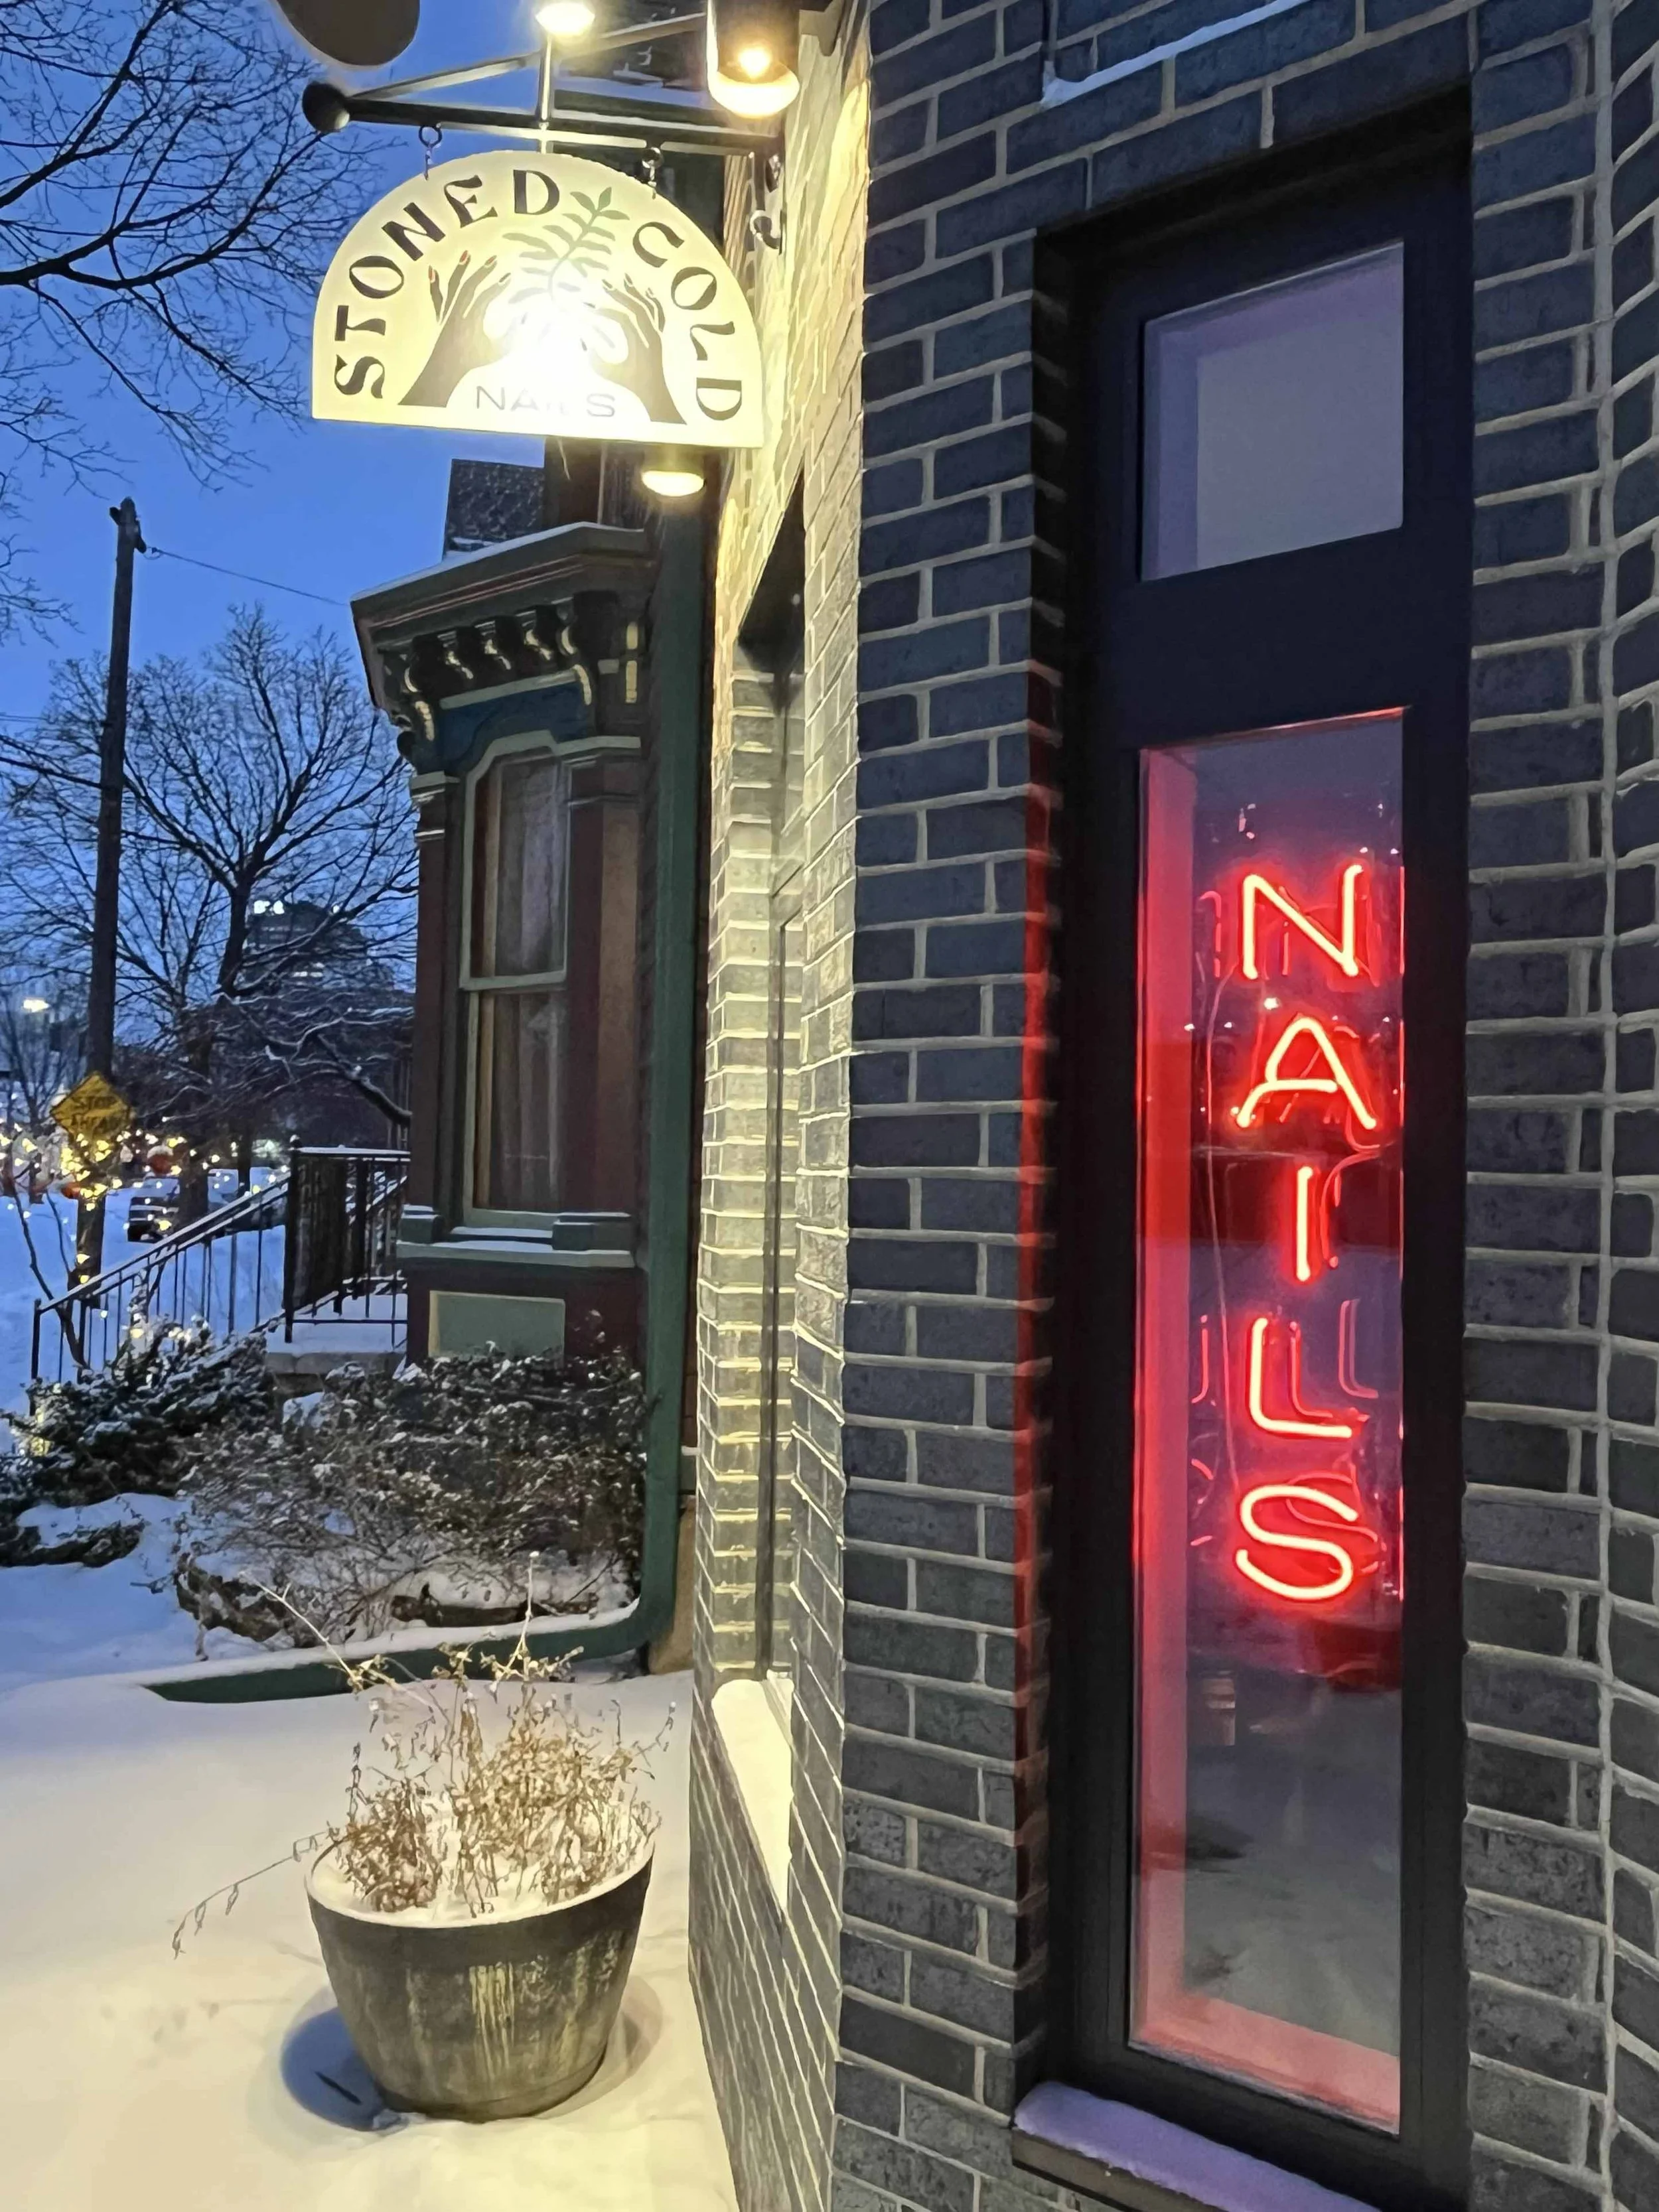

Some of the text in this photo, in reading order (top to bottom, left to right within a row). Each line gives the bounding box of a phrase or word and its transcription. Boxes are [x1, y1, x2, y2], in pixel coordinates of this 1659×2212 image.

[334, 170, 743, 421] STONED COLD
[70, 1096, 117, 1111] STOP
[1234, 864, 1377, 1600] NAILS
